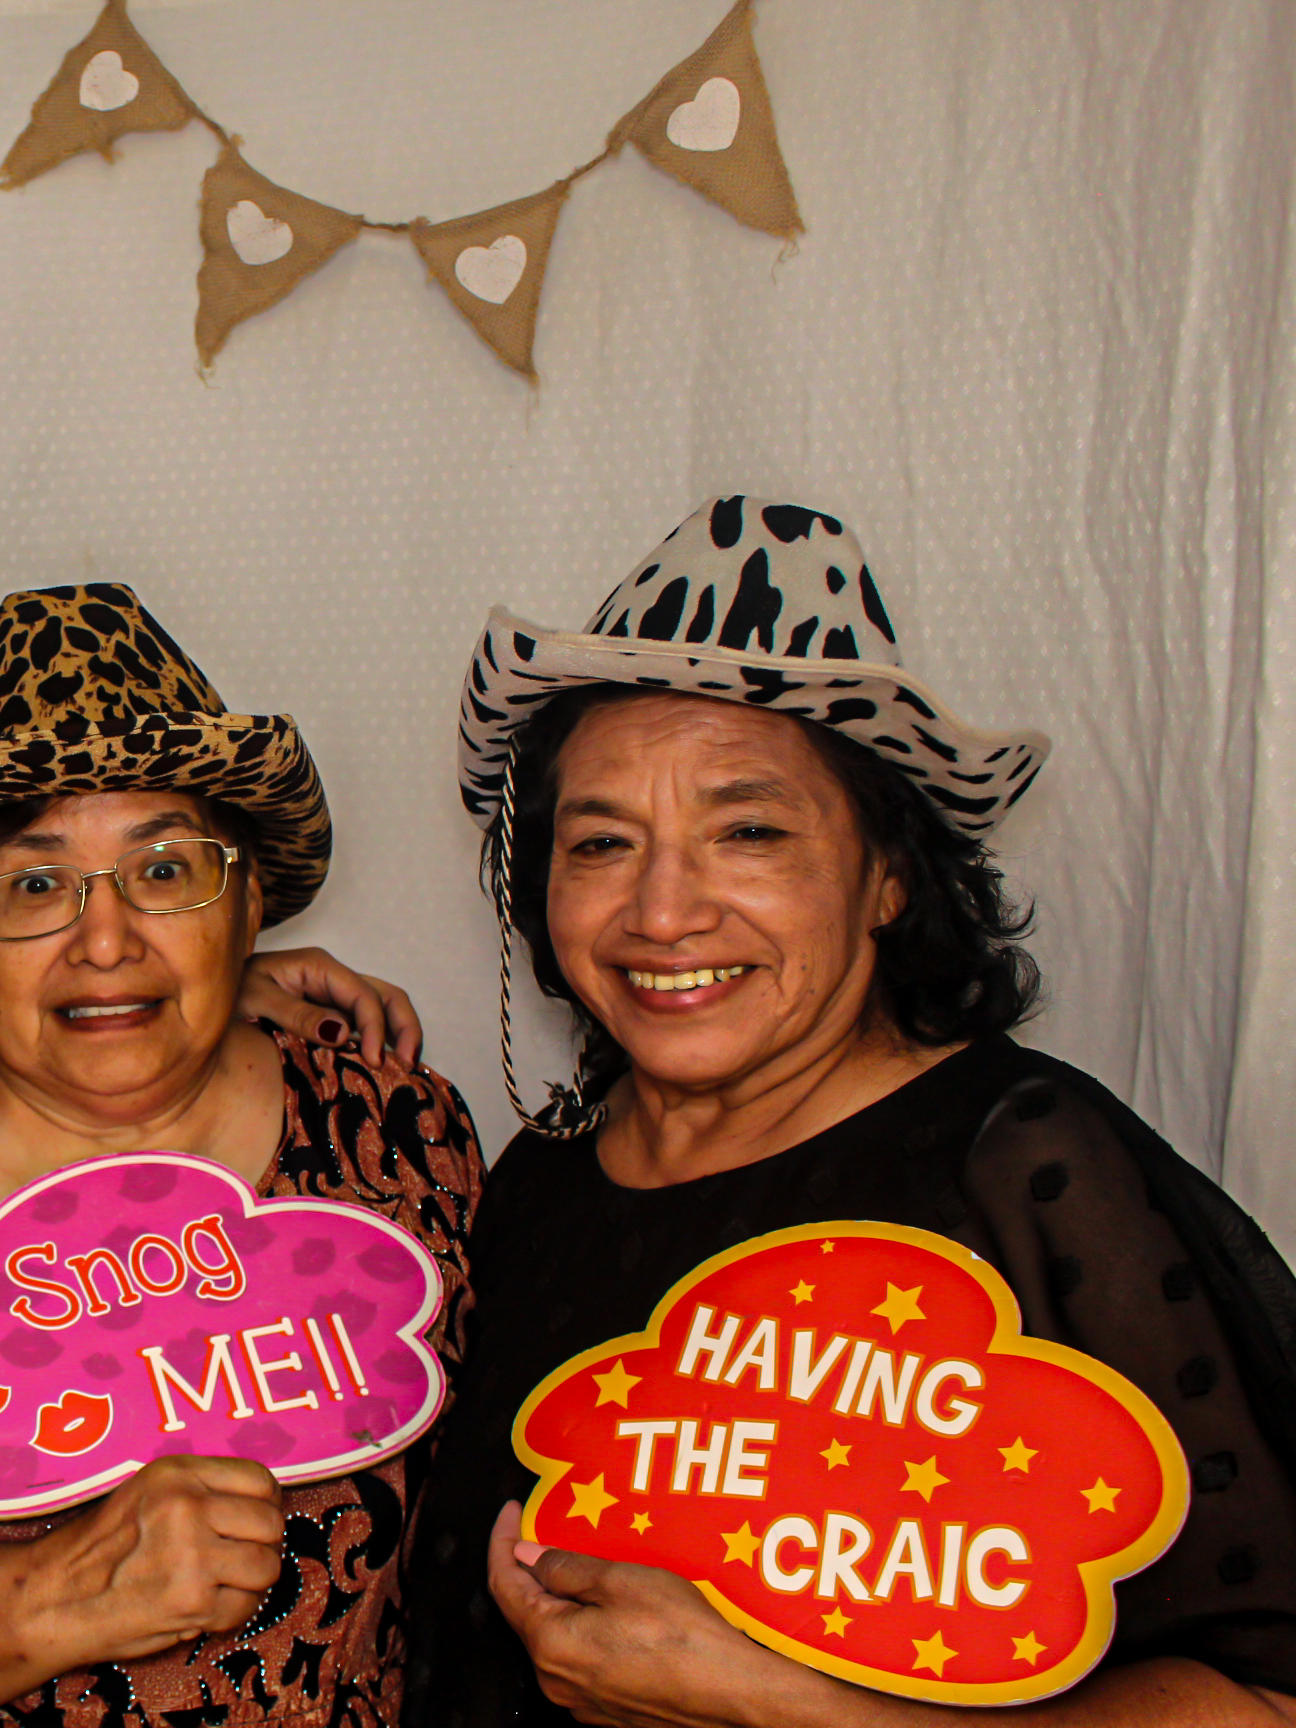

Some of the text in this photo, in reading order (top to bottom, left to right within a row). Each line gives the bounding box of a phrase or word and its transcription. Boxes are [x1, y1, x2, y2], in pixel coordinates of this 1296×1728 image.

[5, 1214, 247, 1330] Snog
[137, 1313, 370, 1433] ME!!
[676, 1303, 985, 1437] HAVING
[615, 1418, 779, 1499] THE
[760, 1511, 1032, 1610] CRAIC
